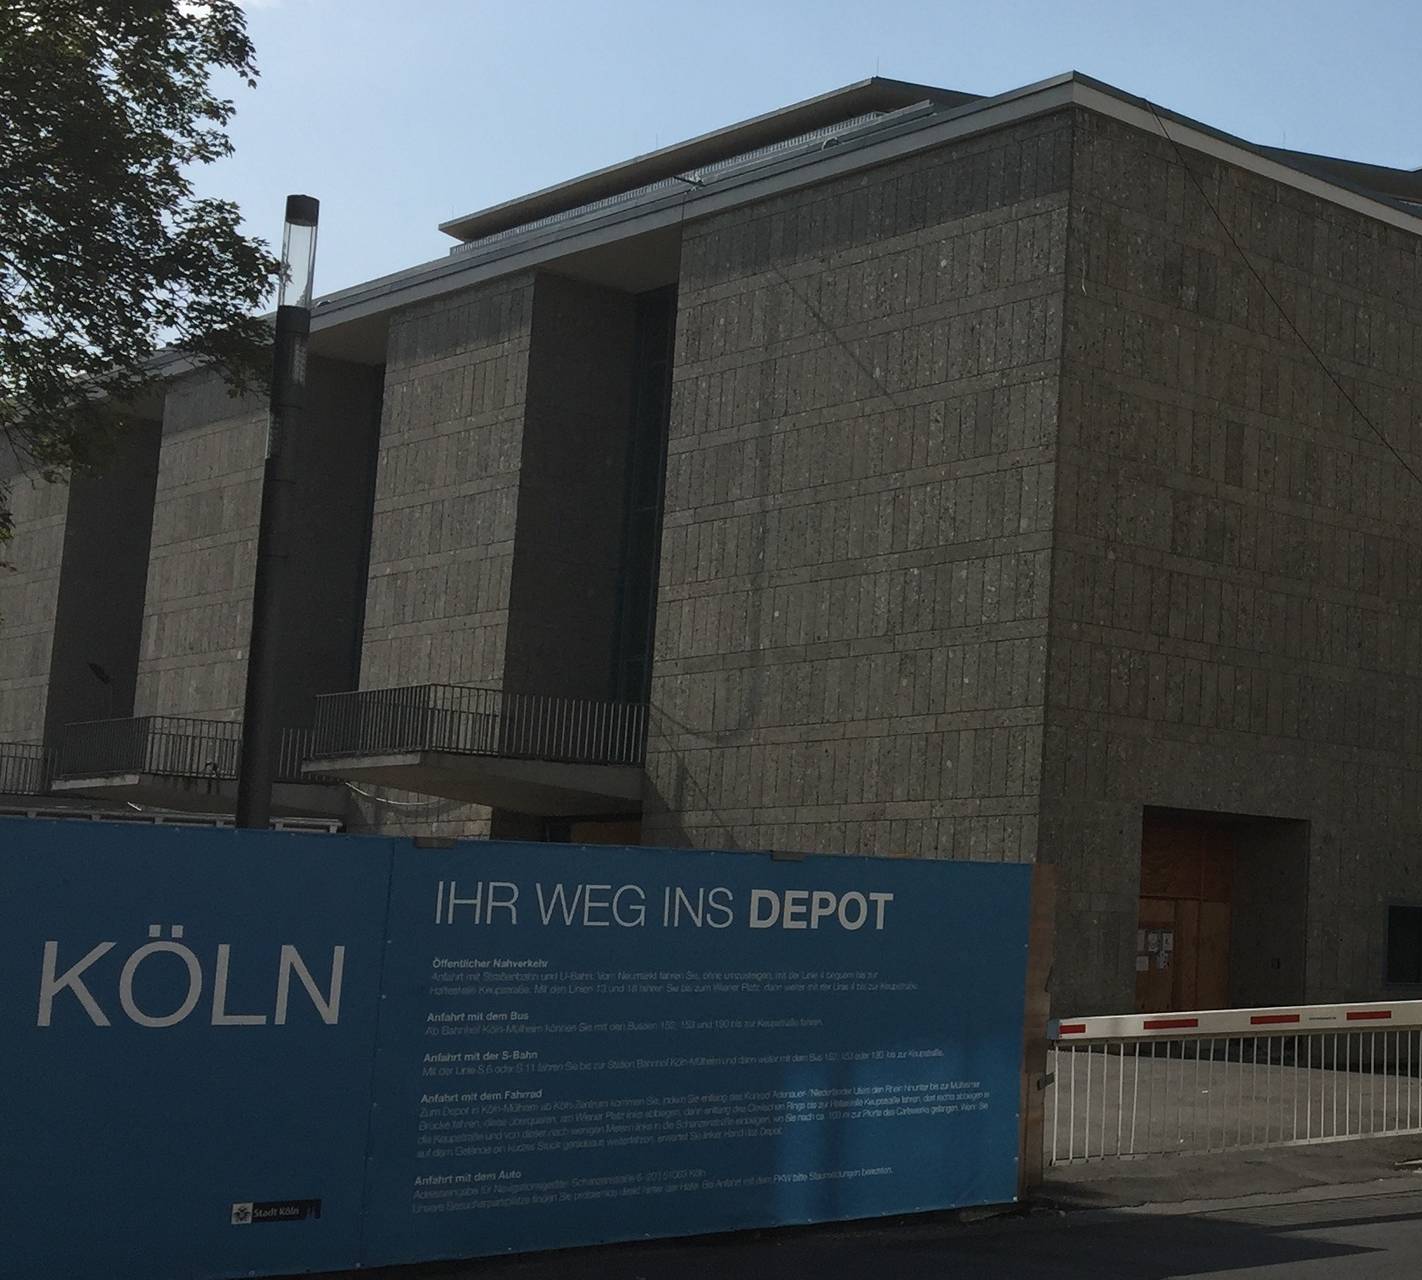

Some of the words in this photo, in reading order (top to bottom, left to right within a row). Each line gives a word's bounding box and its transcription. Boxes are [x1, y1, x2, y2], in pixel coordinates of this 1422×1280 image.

[435, 880, 521, 925] IHR
[536, 884, 646, 927] WEG
[663, 886, 734, 928] INS
[749, 889, 894, 931] DEPOT
[432, 957, 490, 969] Öffentlicher
[493, 957, 548, 969] Nahverkehr
[36, 924, 345, 1027] KÖLN
[427, 1012, 465, 1023] Anfahrt
[467, 1012, 483, 1022] mit
[486, 1011, 507, 1021] dem
[510, 1011, 529, 1021] Bus
[423, 1053, 461, 1064] Anfahrt
[464, 1052, 480, 1062] mit
[483, 1052, 499, 1062] der
[502, 1050, 539, 1061] S-Bahn
[420, 1093, 459, 1104] Anfahrt
[461, 1092, 477, 1102] mit
[480, 1091, 501, 1101] dem
[504, 1089, 543, 1100] Fahrrad
[414, 1175, 453, 1187] Anfahrt
[455, 1173, 472, 1184] mit
[474, 1172, 496, 1182] dem
[497, 1170, 522, 1180] Auto
[254, 1207, 277, 1217] Stadt
[278, 1206, 299, 1216] Köln
